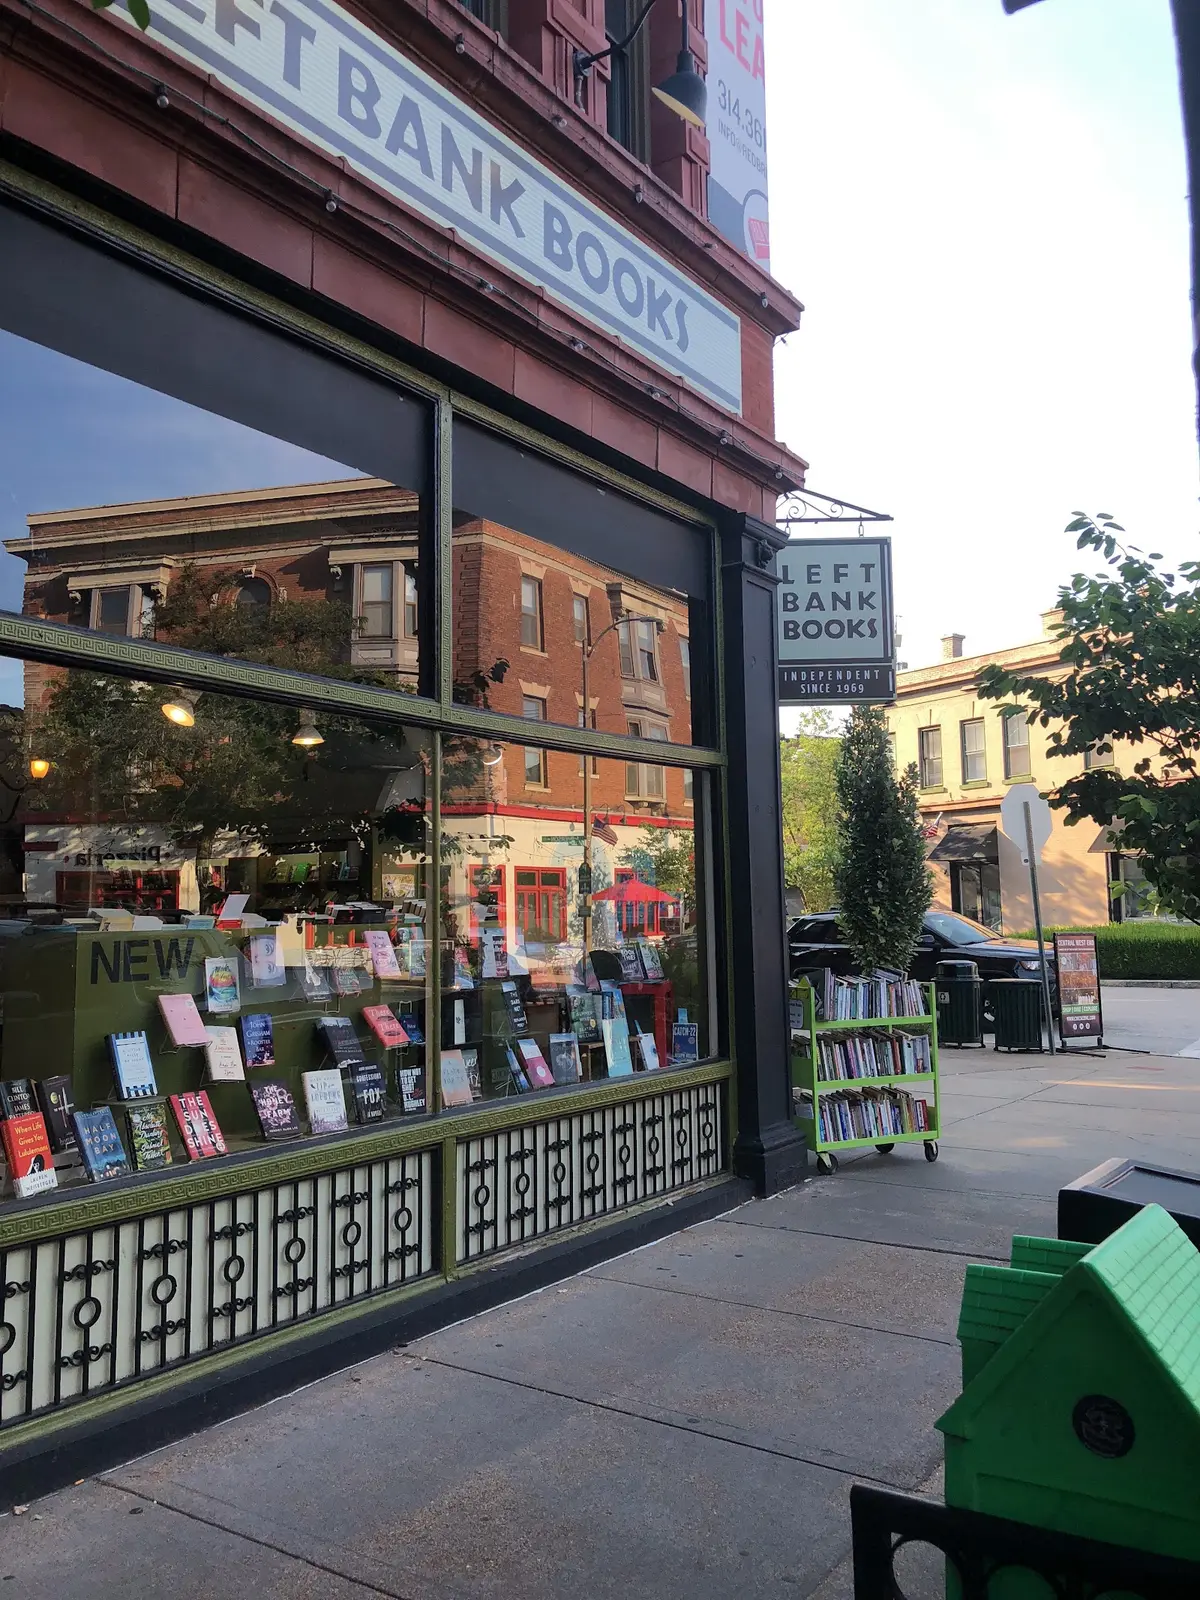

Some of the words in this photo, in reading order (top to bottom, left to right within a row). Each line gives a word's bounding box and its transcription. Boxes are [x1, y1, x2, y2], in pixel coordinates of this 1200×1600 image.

[337, 46, 526, 238] BANK
[543, 199, 690, 353] BOOKS
[781, 563, 876, 585] LEFT
[782, 591, 877, 613] BANK
[783, 618, 878, 640] BOOKS
[784, 669, 880, 681] INDEPENDENT
[800, 684, 831, 693] SINCE
[836, 683, 865, 693] 1969
[90, 937, 195, 984] NEW
[368, 1008, 391, 1017] There
[249, 1021, 266, 1030] JOHN
[378, 1023, 400, 1032] There
[673, 1026, 696, 1037] CATCH-22
[246, 1030, 271, 1038] GRISHAM
[12, 1085, 24, 1094] BILL
[264, 1085, 278, 1094] THE
[258, 1096, 288, 1107] HONEY
[363, 1087, 381, 1105] FOX
[14, 1102, 31, 1113] JAMES
[178, 1095, 204, 1110] THE
[183, 1109, 209, 1121] SUN
[267, 1108, 292, 1119] FARM
[14, 1124, 33, 1135] When
[32, 1122, 42, 1132] Life
[84, 1122, 111, 1135] HALF
[18, 1137, 34, 1146] Gives
[34, 1134, 44, 1142] You
[86, 1132, 117, 1146] MOON
[187, 1132, 225, 1149] SHINE
[94, 1143, 115, 1155] BAY
